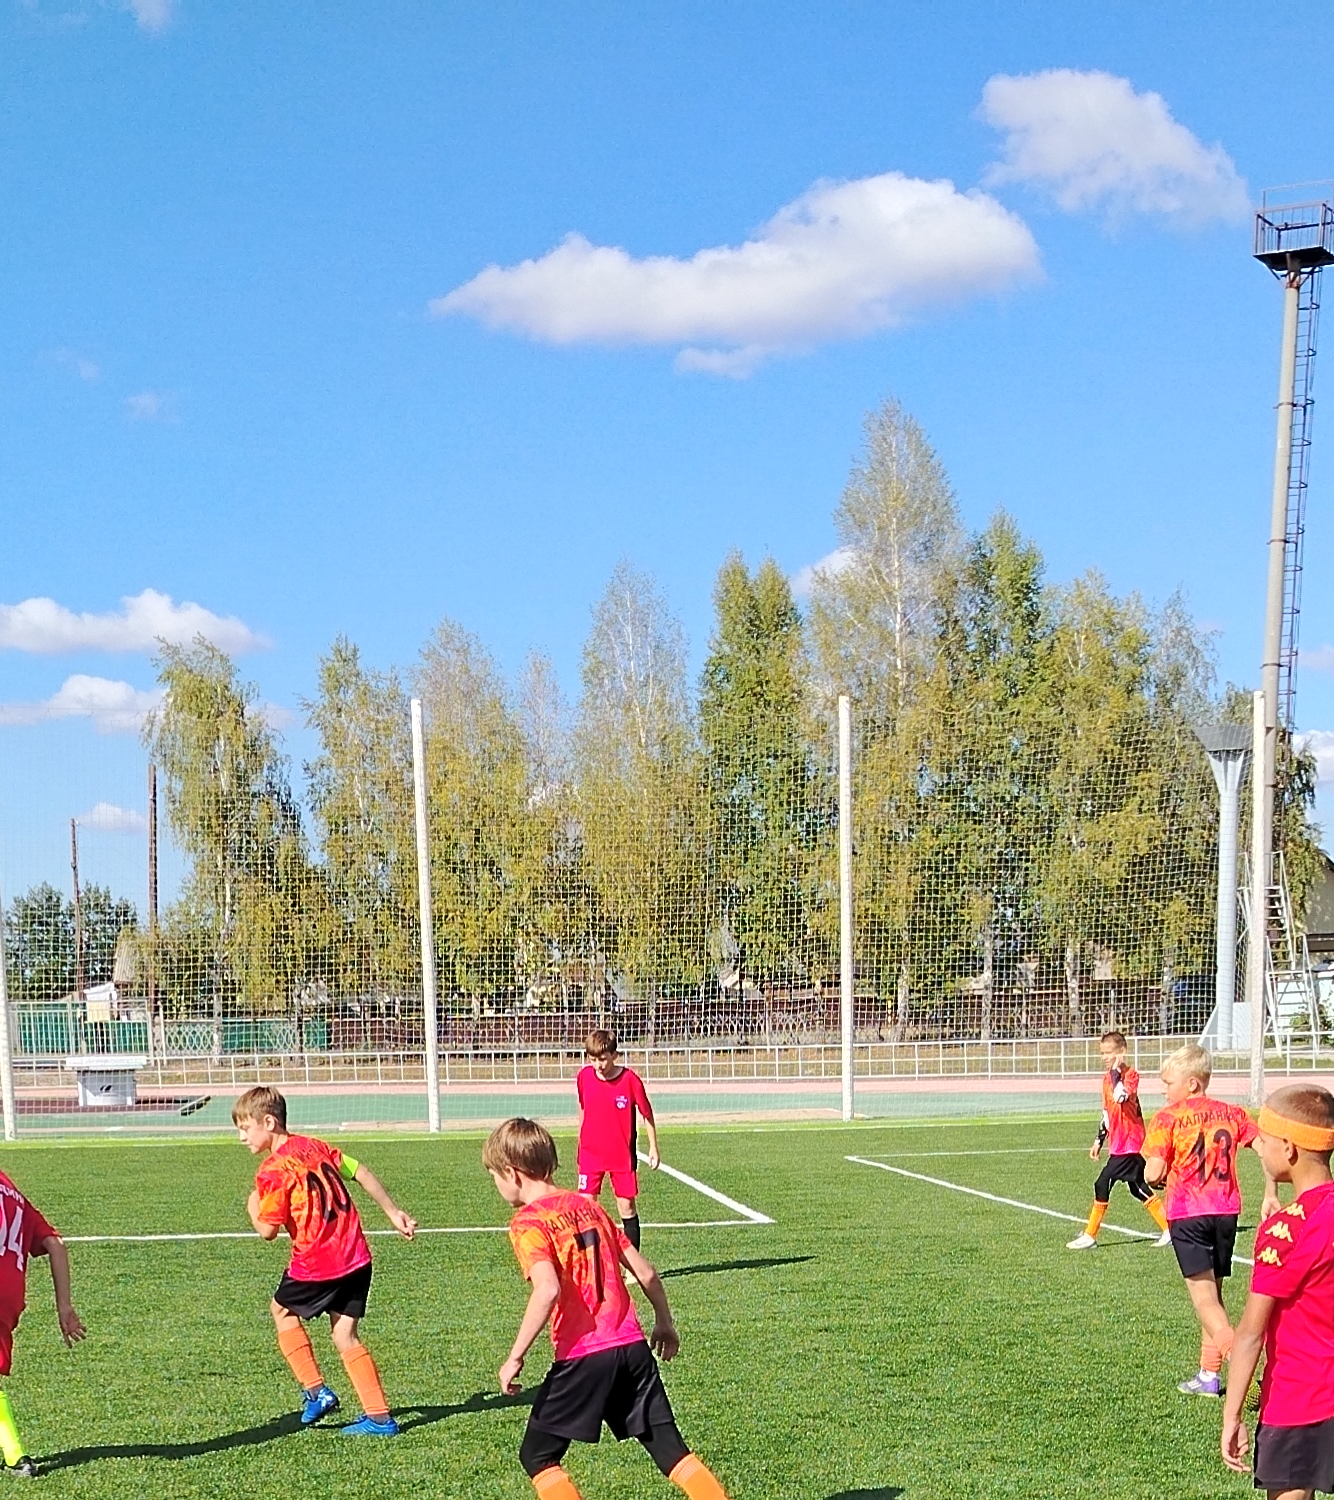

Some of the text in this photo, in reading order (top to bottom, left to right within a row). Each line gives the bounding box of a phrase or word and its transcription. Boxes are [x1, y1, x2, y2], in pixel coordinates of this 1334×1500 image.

[1189, 1129, 1232, 1183] 13
[307, 1161, 351, 1223] 20
[573, 1227, 605, 1303] 7
